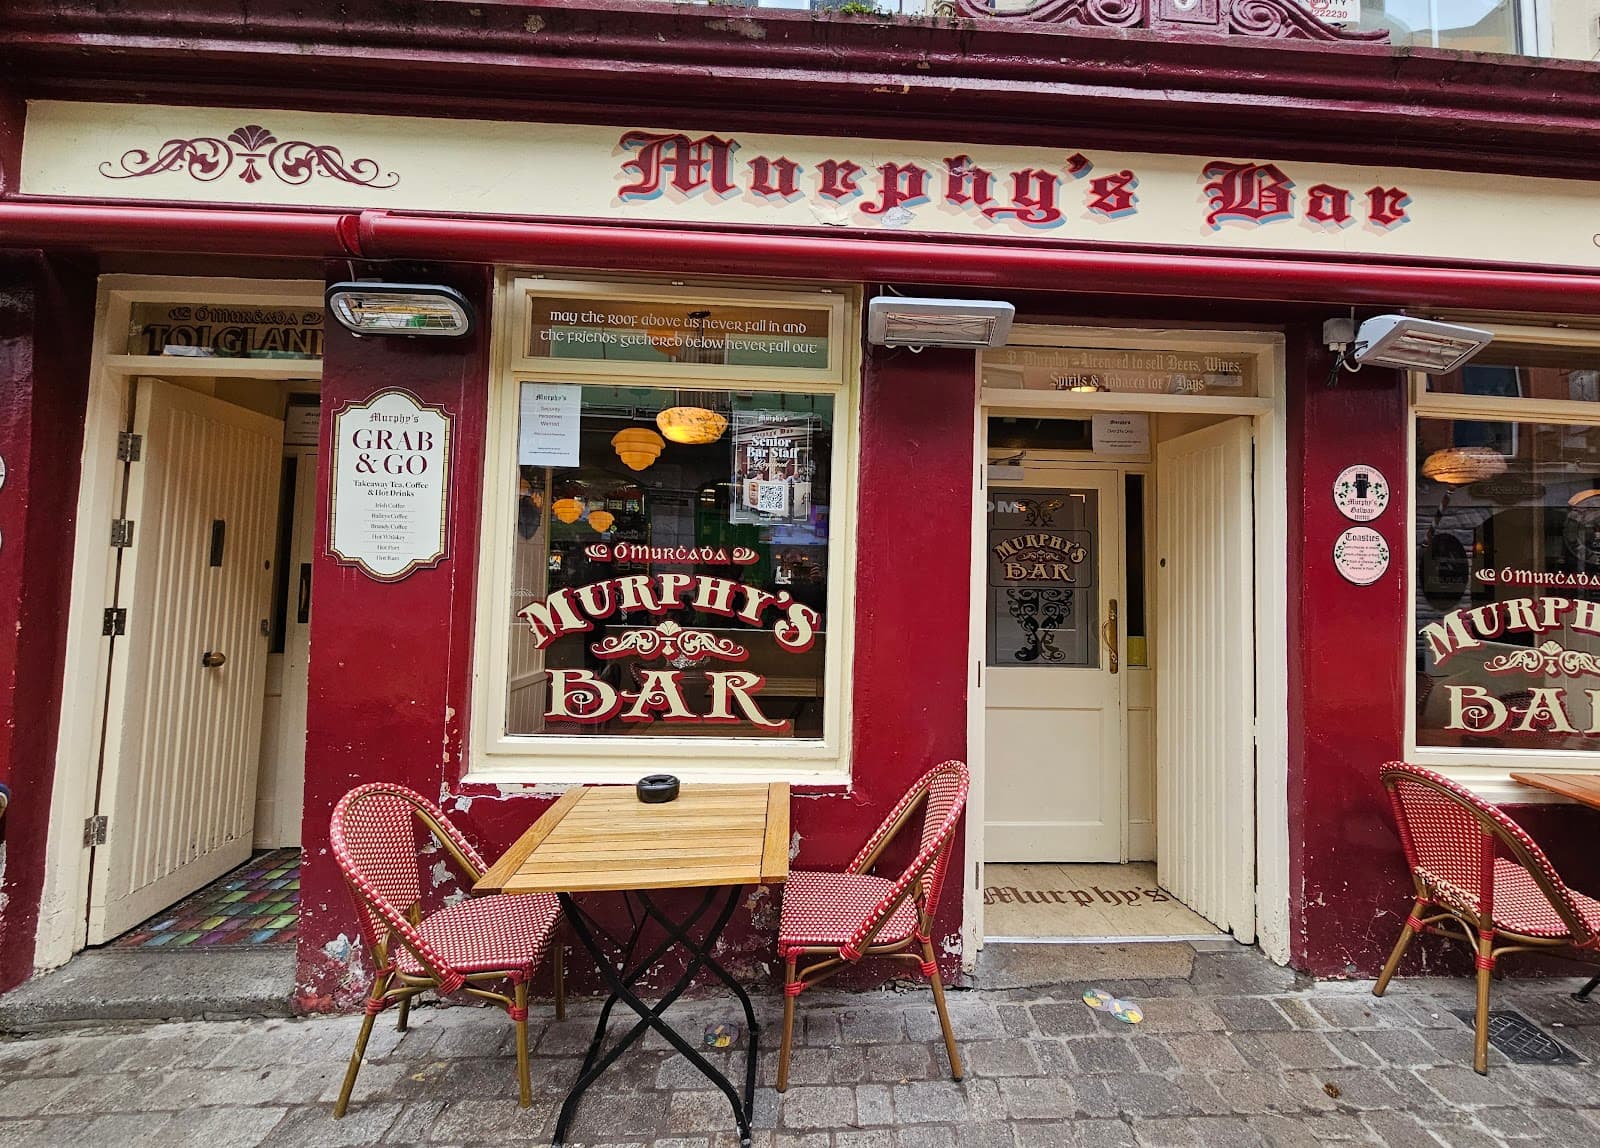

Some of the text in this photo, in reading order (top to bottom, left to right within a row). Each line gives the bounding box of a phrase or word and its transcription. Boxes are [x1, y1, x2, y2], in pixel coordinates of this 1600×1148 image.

[617, 129, 1412, 231] Murphy's Bar
[550, 311, 578, 325] may
[581, 311, 605, 323] the
[641, 313, 681, 327] above
[768, 320, 779, 332] in
[783, 322, 807, 334] and
[540, 329, 564, 341] the
[685, 335, 724, 349] below
[792, 343, 817, 354] out
[1090, 374, 1099, 386] &
[369, 412, 420, 424] Murphy's
[352, 428, 434, 452] GRAB
[752, 435, 792, 447] Senior
[747, 446, 800, 458] Bar Staff
[355, 452, 428, 476] & GO
[353, 480, 429, 490] Takeaway Tea, Coffee
[991, 533, 1088, 563] MURPHY'S
[1345, 532, 1380, 542] Toasties
[1003, 561, 1076, 583] BAR
[516, 573, 821, 652] MURPHY'S
[543, 668, 791, 732] BAR
[1444, 685, 1600, 734] BA
[983, 885, 1170, 908] Murphy's
